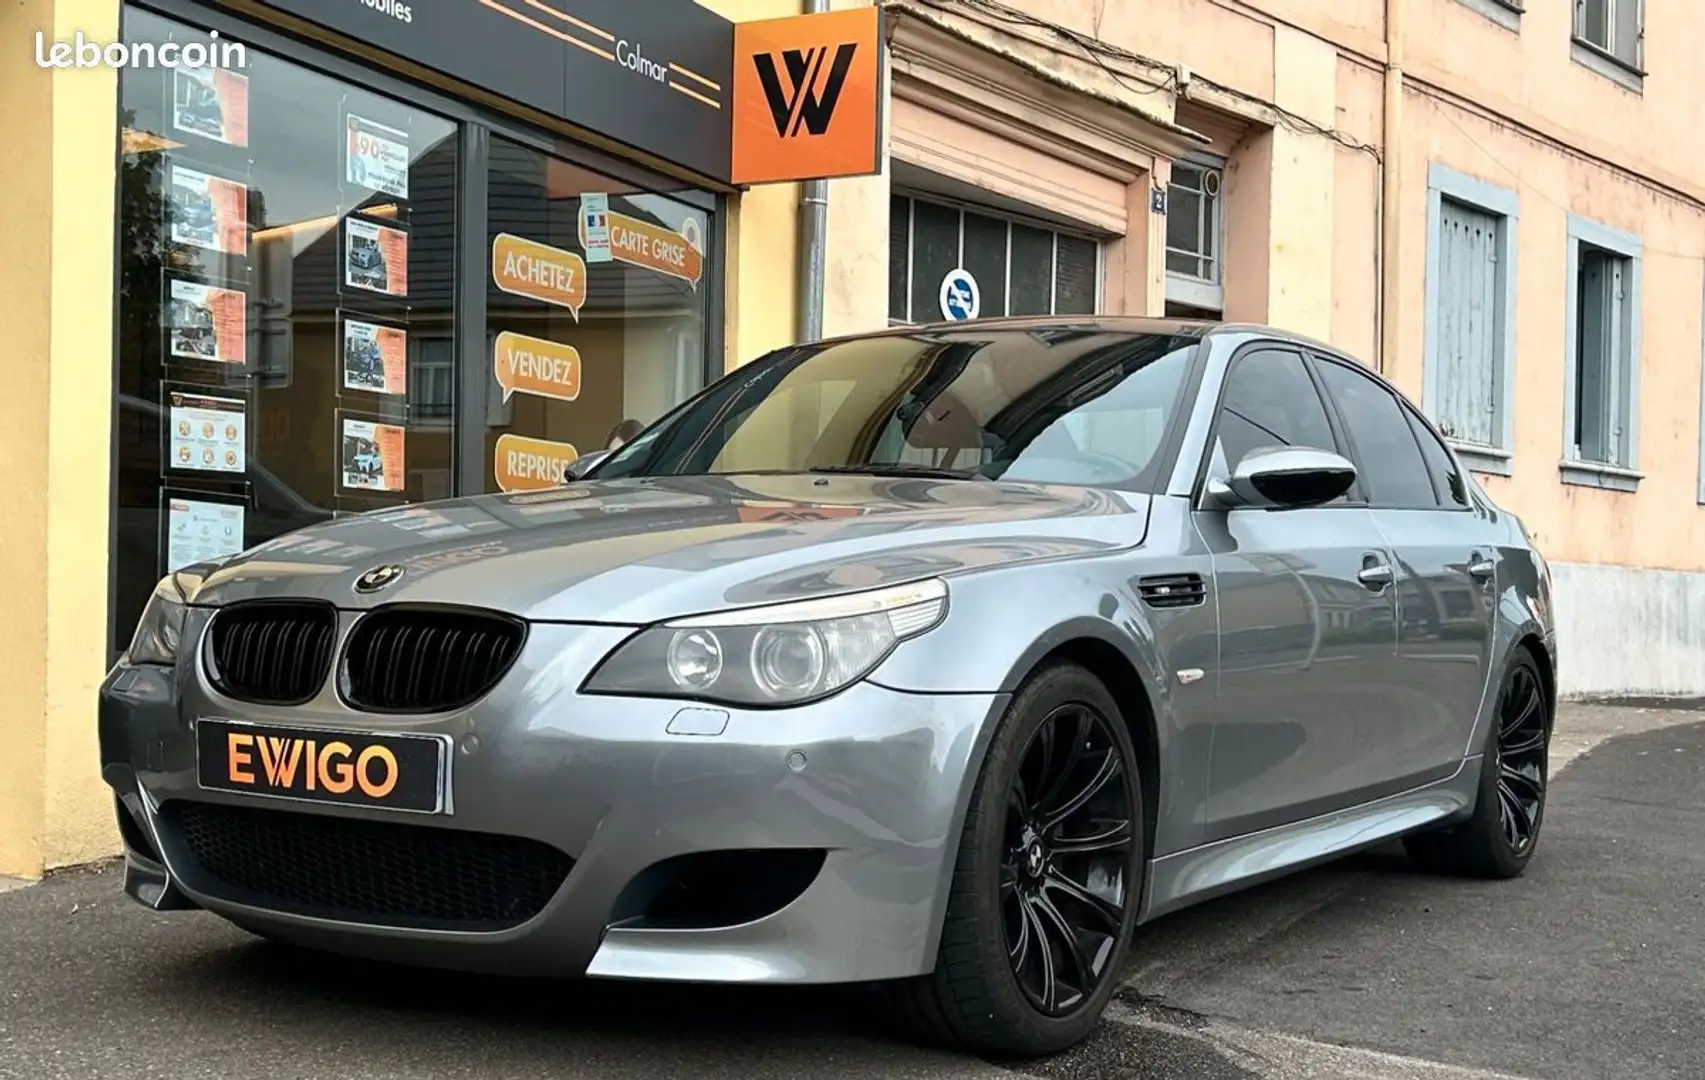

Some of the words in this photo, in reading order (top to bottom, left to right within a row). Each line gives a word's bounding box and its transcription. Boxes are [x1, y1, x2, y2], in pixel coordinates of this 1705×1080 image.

[616, 40, 667, 83] Colmar
[1155, 193, 1162, 209] 2
[611, 226, 649, 256] CARTE
[652, 238, 685, 267] GRISE
[503, 250, 575, 293] ACHETEZ
[507, 347, 572, 386] VENDEZ
[228, 733, 399, 798] EWIGO
